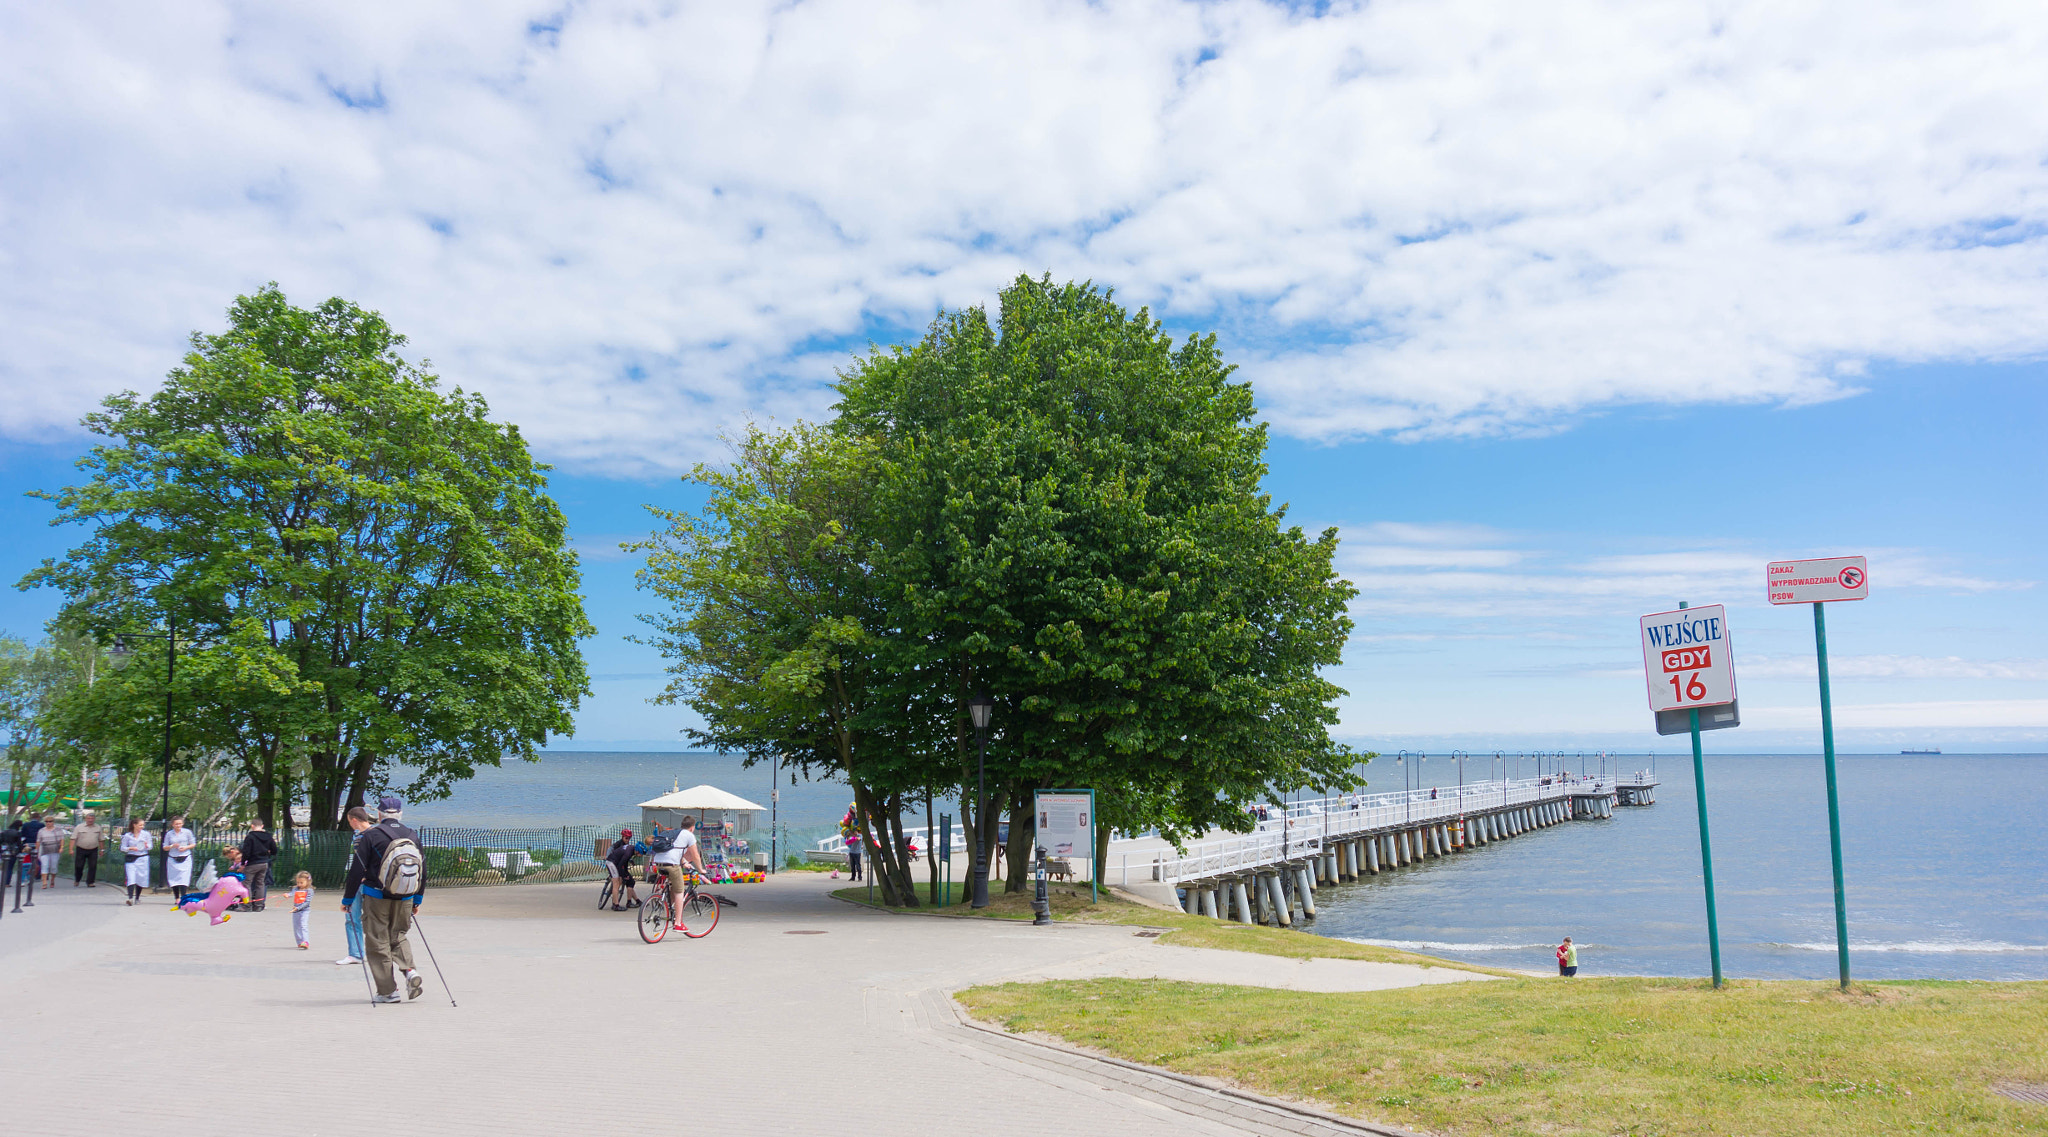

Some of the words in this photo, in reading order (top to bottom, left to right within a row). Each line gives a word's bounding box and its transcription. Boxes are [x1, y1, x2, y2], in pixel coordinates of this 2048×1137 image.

[1770, 566, 1794, 574] ZAKAZ
[1771, 577, 1837, 587] WYPROWADZANIA
[1647, 615, 1721, 648] WEJŚCIE
[1664, 648, 1708, 669] GDY
[1670, 672, 1707, 702] 16
